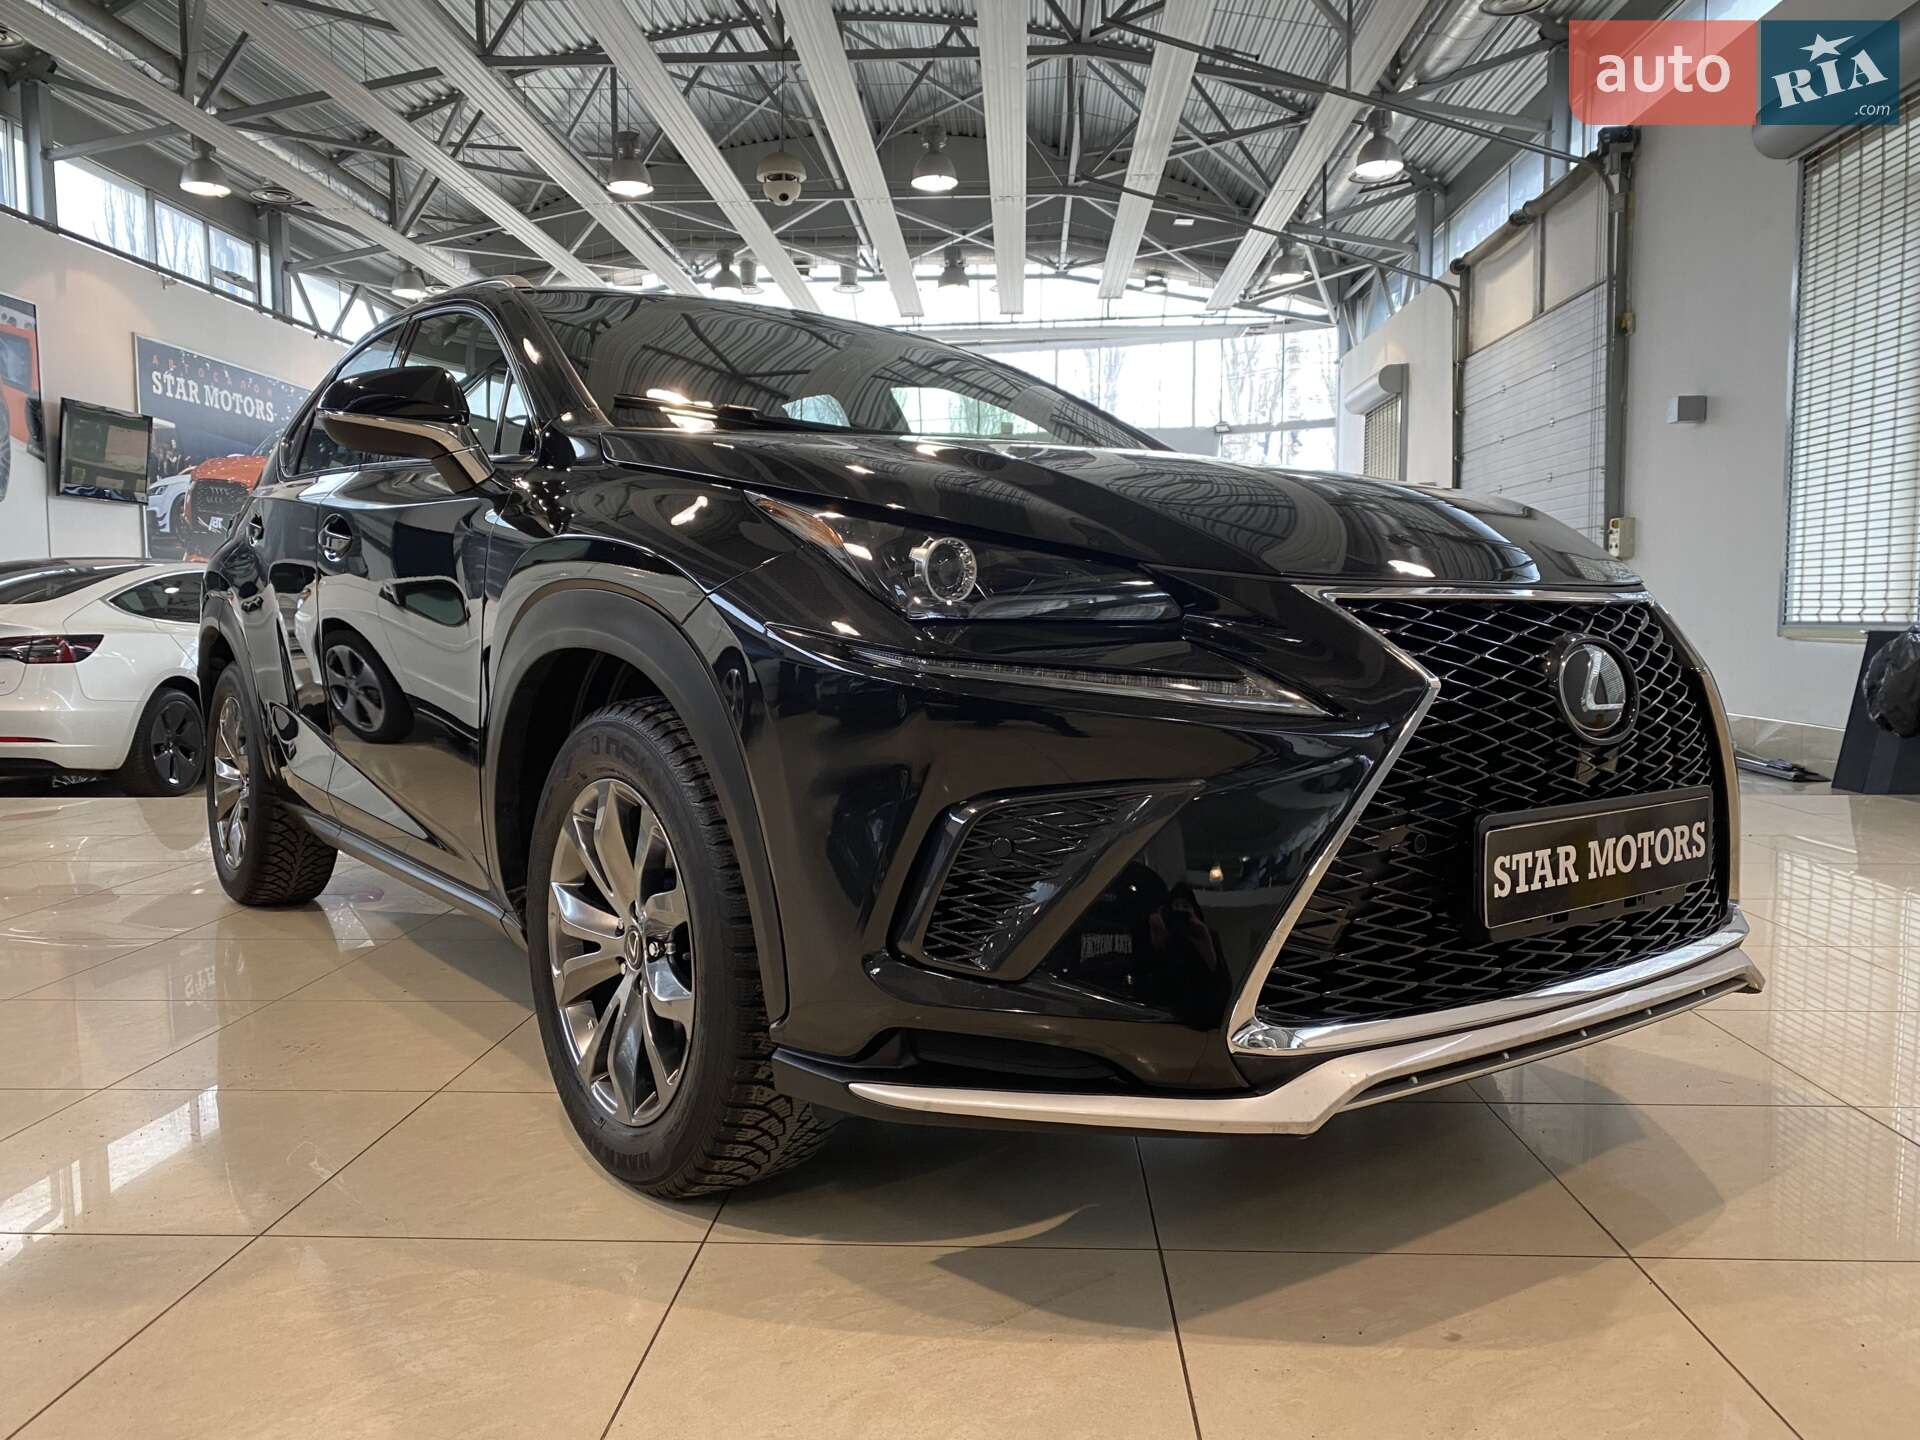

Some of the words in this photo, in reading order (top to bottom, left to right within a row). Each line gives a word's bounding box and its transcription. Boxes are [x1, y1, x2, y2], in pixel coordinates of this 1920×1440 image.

[152, 370, 200, 404] STAR
[203, 384, 275, 423] MOTORS
[1493, 844, 1579, 899] STAR
[1588, 821, 1706, 880] MOTORS
